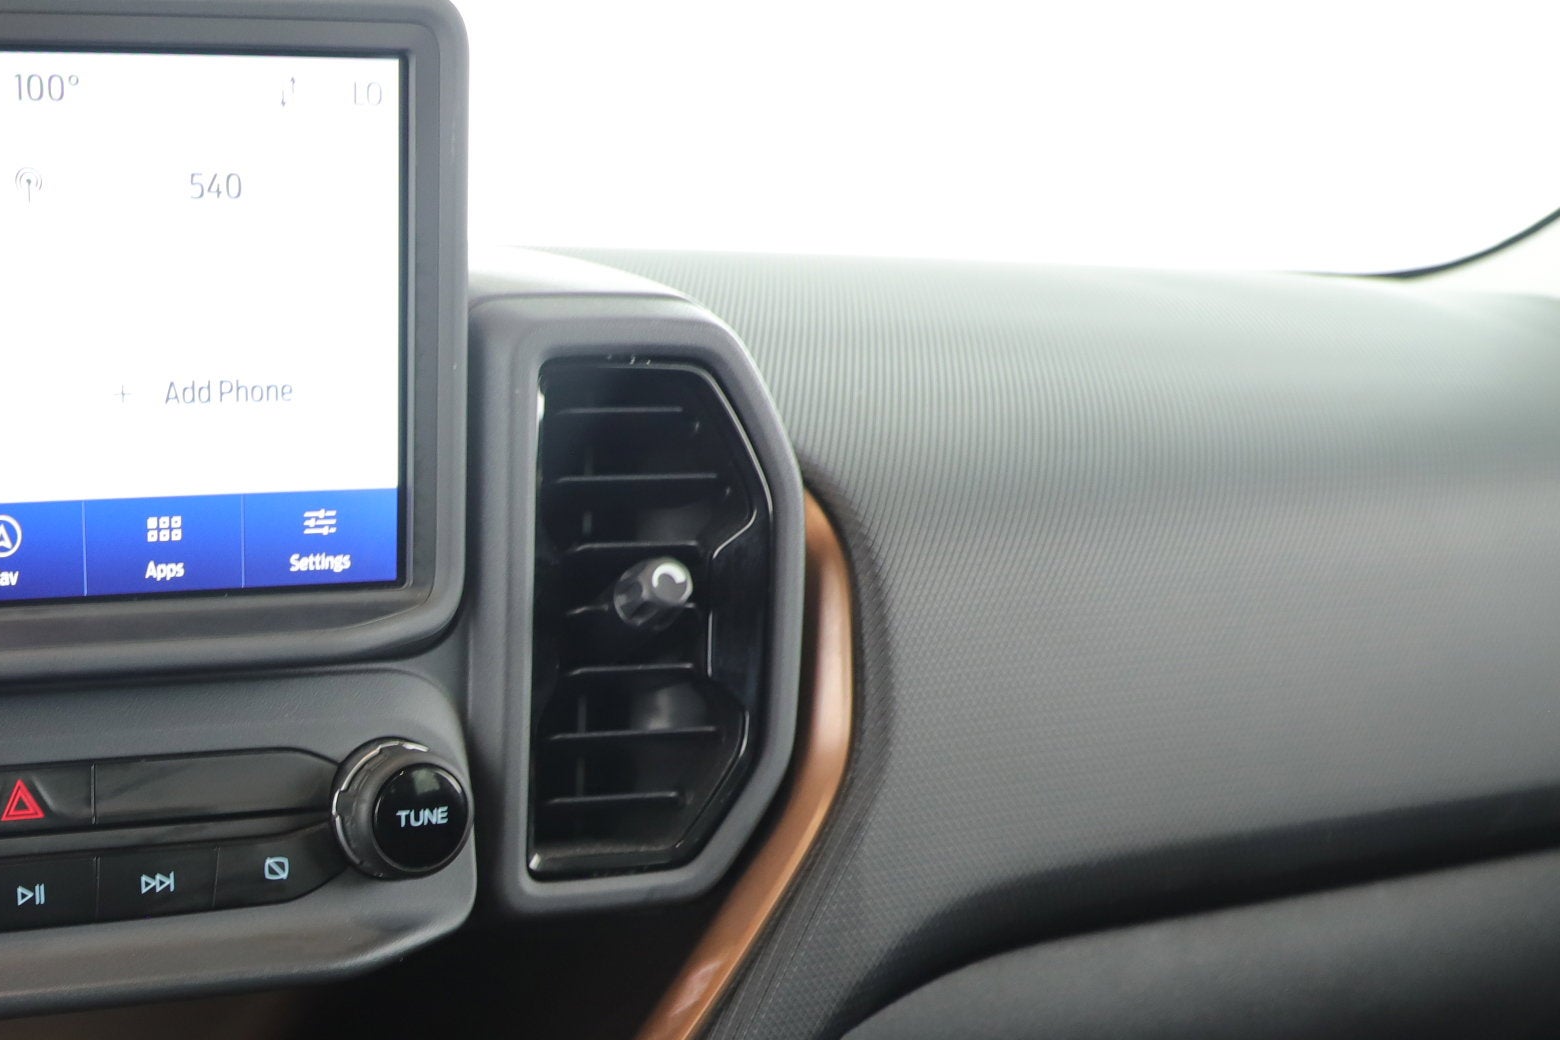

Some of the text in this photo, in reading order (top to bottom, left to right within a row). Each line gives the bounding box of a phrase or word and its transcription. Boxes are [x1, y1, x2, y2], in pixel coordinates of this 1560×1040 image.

[13, 73, 80, 101] 100°
[352, 81, 383, 106] LO
[189, 172, 242, 200] 540
[165, 379, 294, 405] Add Phone
[145, 559, 185, 582] Apps
[289, 552, 351, 574] Settings
[396, 806, 449, 828] TUNE
